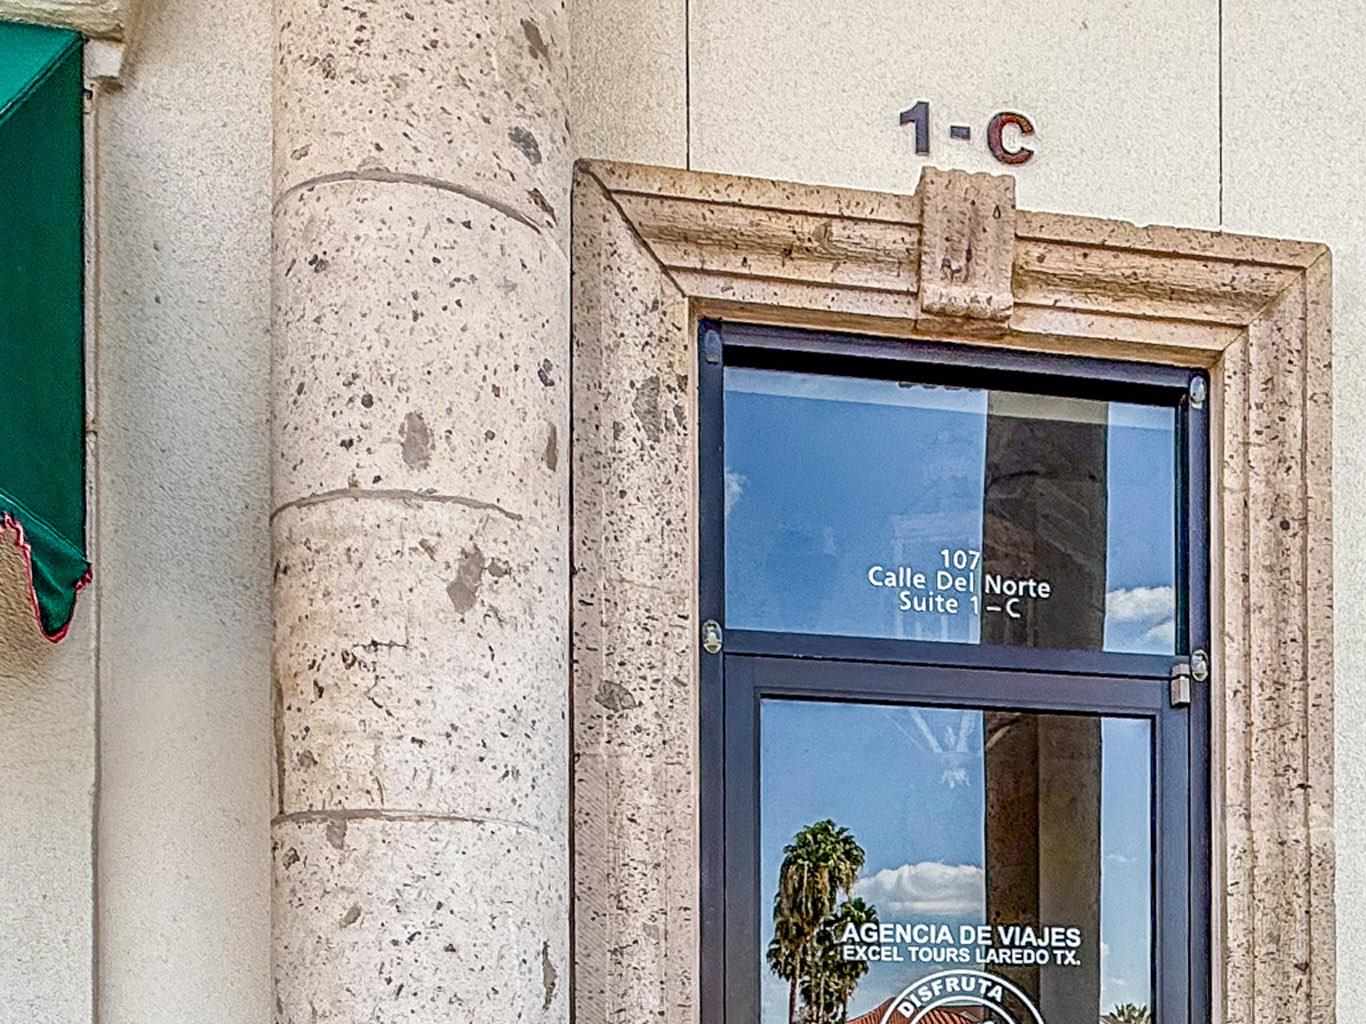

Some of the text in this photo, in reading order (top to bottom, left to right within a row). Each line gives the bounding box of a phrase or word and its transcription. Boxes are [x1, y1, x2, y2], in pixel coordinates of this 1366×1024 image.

[940, 549, 981, 569] 107
[868, 566, 1051, 598] Calle Del Norte
[899, 591, 959, 614] Suite
[842, 923, 1081, 948] AGENCIA DE VIAJES
[843, 945, 1081, 966] EXCEL TOURS LAREDO TX.
[897, 977, 1005, 1019] DISFRUTA
